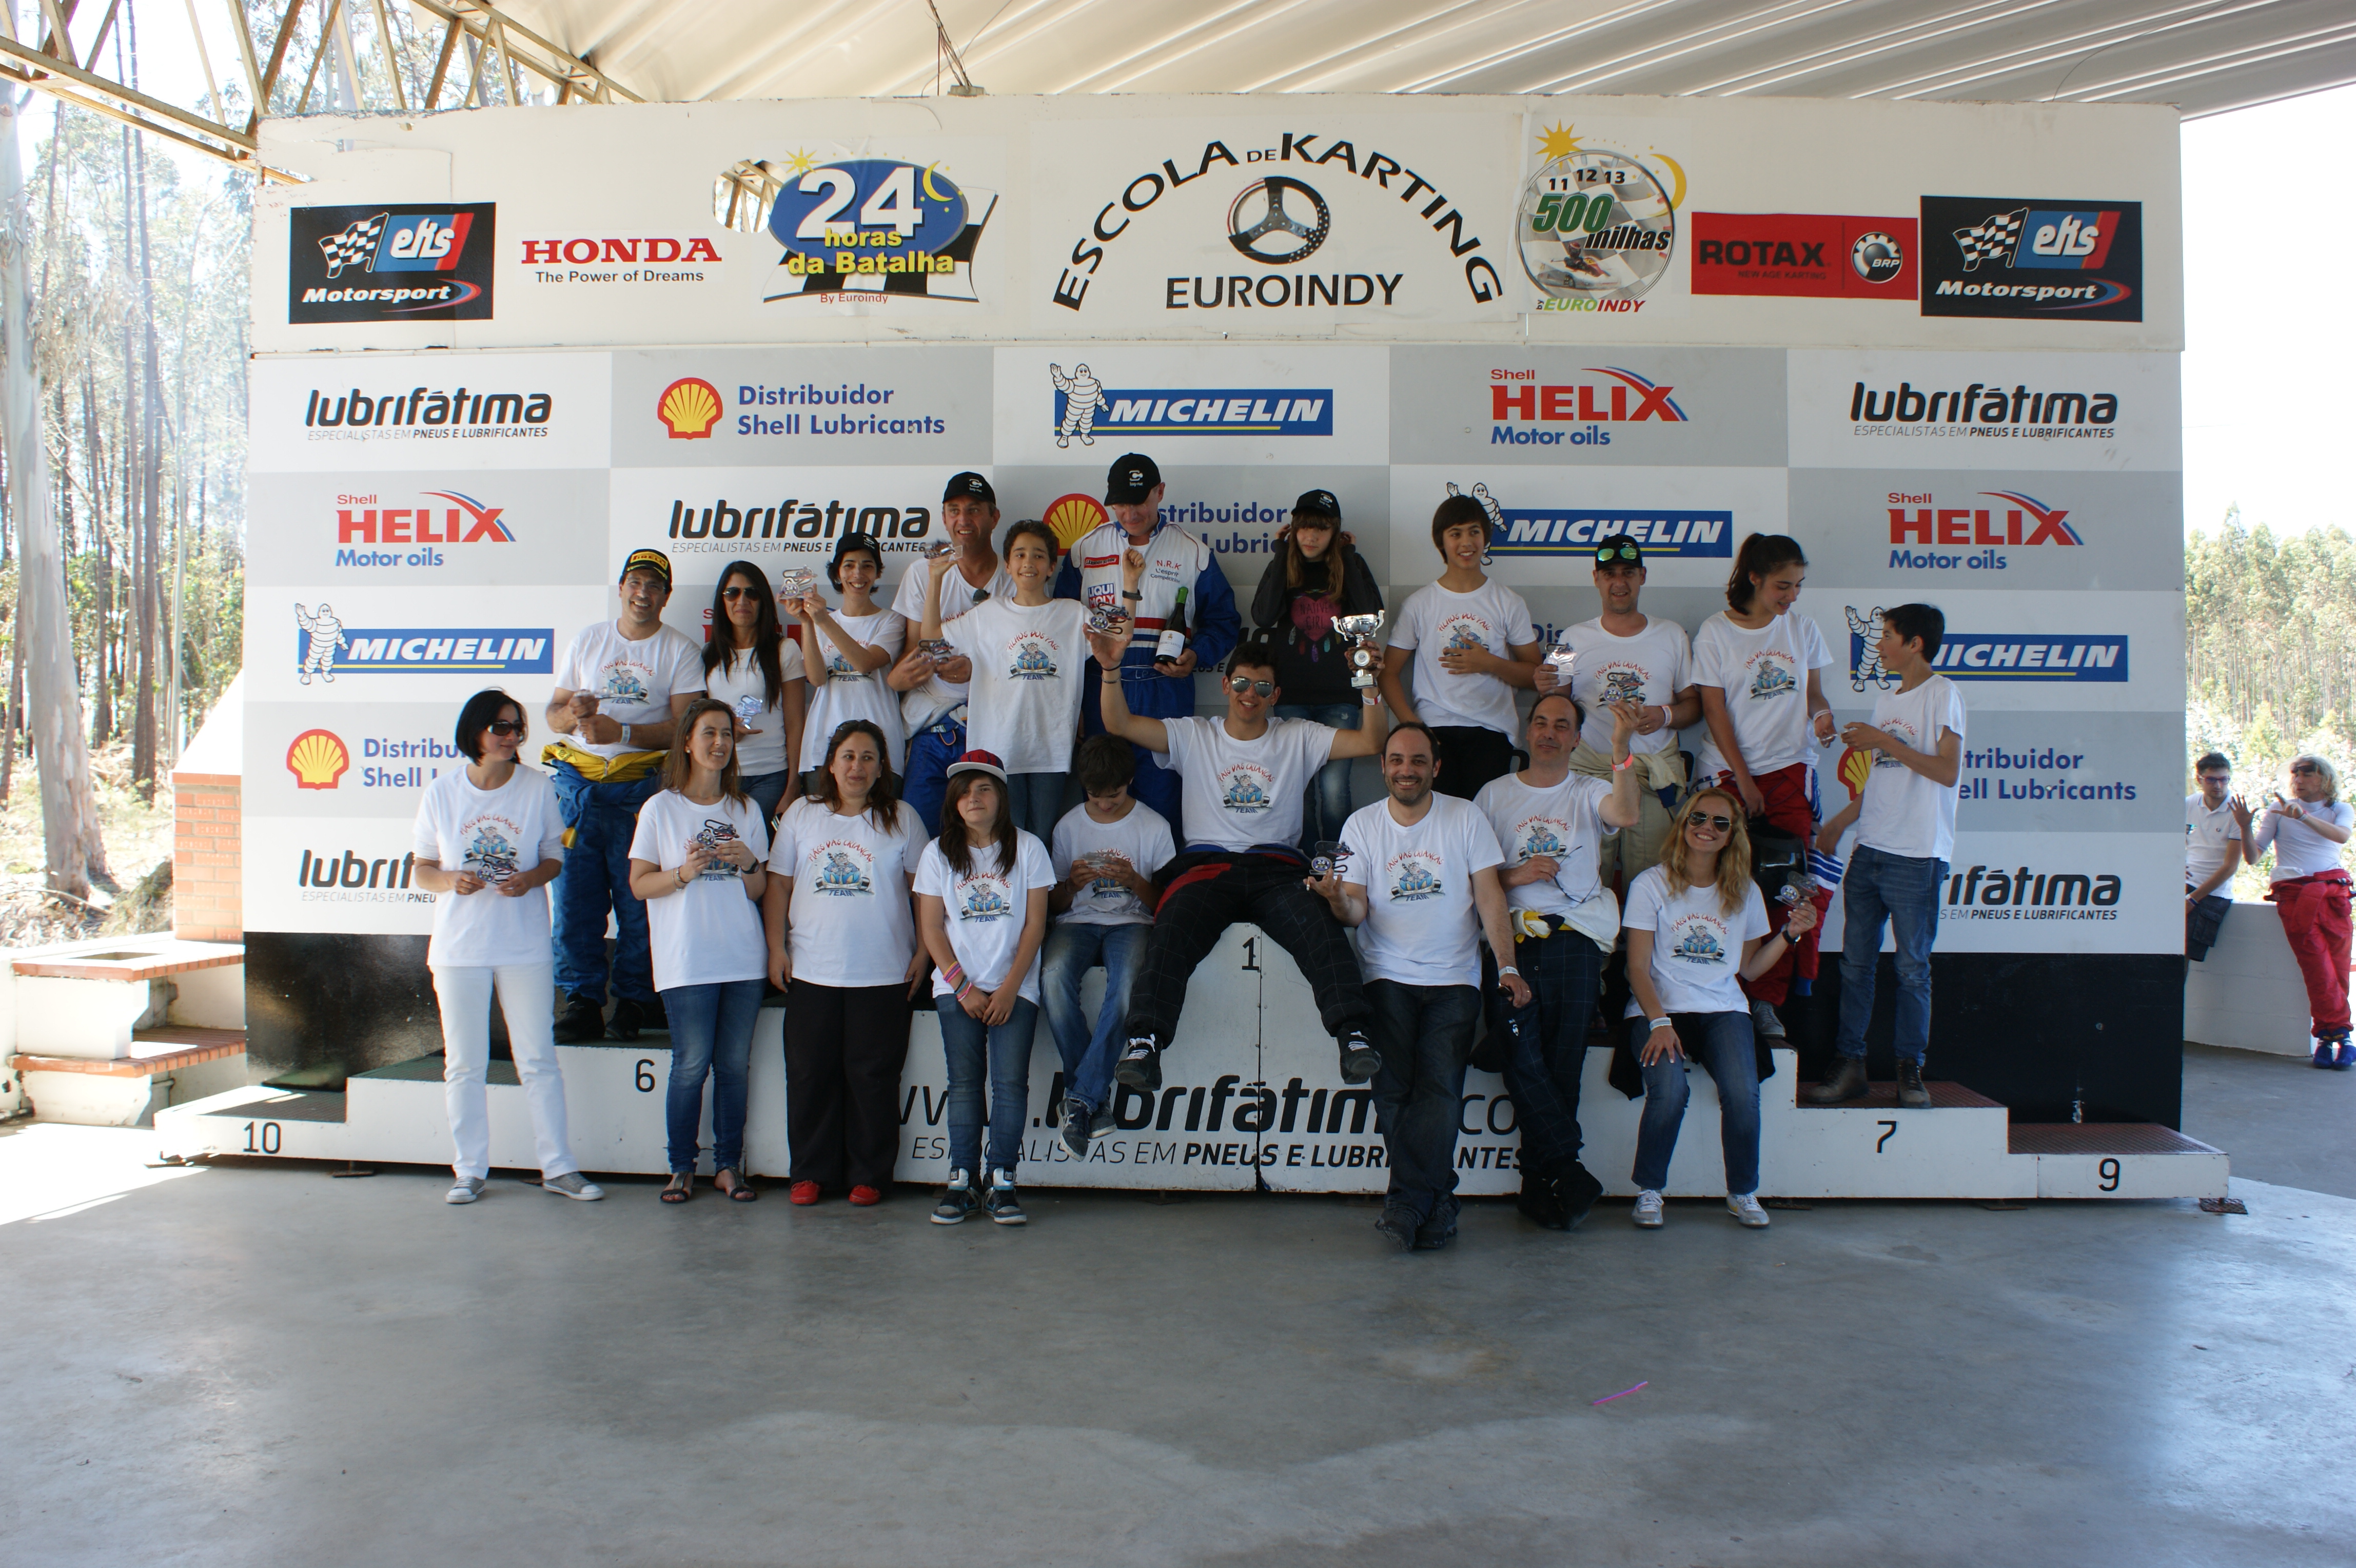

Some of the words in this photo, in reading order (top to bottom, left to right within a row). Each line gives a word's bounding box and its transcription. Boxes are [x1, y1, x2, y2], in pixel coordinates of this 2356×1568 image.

[1548, 178, 1569, 191] 11
[1576, 169, 1598, 183] 12
[1603, 171, 1626, 185] 13
[795, 167, 925, 240] 24
[1531, 193, 1615, 234] 500
[1052, 140, 1239, 311] ESCOLA
[1246, 149, 1277, 162] DE
[1281, 132, 1503, 304] KARTING
[824, 227, 903, 249] horas
[1583, 225, 1672, 251] milhas
[520, 238, 723, 265] HONDA
[1699, 239, 1825, 267] ROTAX
[788, 251, 824, 277] da
[835, 250, 955, 275] Batalha
[1872, 258, 1900, 268] BRP
[535, 270, 564, 283] The
[568, 269, 619, 282] Power
[623, 269, 640, 282] of
[643, 269, 705, 282] Dreams
[1738, 270, 1761, 279] NEW
[1763, 270, 1784, 279] AGE
[1785, 270, 1827, 280] KARTING
[302, 285, 451, 305] Motorsport
[821, 292, 835, 304] By
[838, 292, 889, 305] Euroindy
[1165, 273, 1404, 310] EUROINDY
[1935, 280, 2097, 302] Motorsport
[1544, 298, 1646, 313] EUROINDY
[1490, 369, 1536, 380] Shell
[739, 384, 894, 406] Distribuidor
[1489, 384, 1685, 422] HELIX
[1850, 381, 2118, 424] lubrifátima
[305, 387, 553, 427] lubrifátima
[1109, 399, 1325, 423] MICHELIN
[308, 429, 392, 441] ESPECIALISTAS
[394, 429, 411, 440] EM
[413, 428, 449, 439] PNEUS
[453, 428, 459, 439] E
[461, 426, 548, 438] LUBRIFICANTES
[737, 415, 801, 436] Shell
[810, 413, 946, 436] Lubricants
[1490, 426, 1565, 445] Motor
[1569, 425, 1611, 446] oils
[1853, 425, 1946, 437] ESPECIALISTAS
[1949, 426, 1967, 437] EM
[1969, 426, 2009, 438] PNEUS
[2012, 426, 2019, 438] E
[2021, 426, 2115, 439] LUBRIFICANTES
[337, 494, 377, 505] Shell
[1888, 492, 1932, 504] Shell
[336, 508, 512, 544] HELIX
[1506, 520, 1724, 544] MICHELIN
[1887, 508, 2080, 546] HELIX
[336, 548, 402, 567] Motor
[407, 547, 444, 566] oils
[672, 542, 760, 553] ESPECIALISTAS
[763, 542, 781, 553] EM
[783, 542, 822, 553] PNEUS
[824, 542, 832, 553] E
[1888, 550, 1962, 569] Motor
[1967, 550, 2007, 570] oils
[1088, 583, 1114, 597] LIQUI
[1089, 594, 1114, 608] MOLY
[1300, 601, 1329, 615] NATIVE
[1306, 616, 1325, 630] GIRL
[1437, 613, 1460, 632] FILHOS
[1461, 612, 1477, 621] DOS
[1476, 617, 1492, 631] PAIS
[347, 638, 546, 661] MICHELIN
[1006, 631, 1028, 651] FILHOS
[1030, 630, 1046, 639] DOS
[1045, 636, 1060, 651] PAIS
[1763, 690, 1784, 700] TEAM
[364, 738, 466, 759] Distribu
[1964, 747, 2084, 769] tribuidor
[363, 767, 422, 788] Shell
[1217, 768, 1231, 782] PAIS
[1231, 762, 1245, 773] DAS
[1958, 778, 1988, 799] ell
[1999, 779, 2136, 800] Lubricants
[1528, 814, 1542, 823] DAS
[808, 844, 825, 862] MÃES
[826, 838, 841, 848] DAS
[299, 849, 415, 889] lubrif
[1385, 858, 1399, 872] PAIS
[1399, 851, 1412, 861] DAS
[1944, 865, 2122, 907] ifátima
[302, 891, 386, 903] ESPECIALISTAS
[388, 892, 405, 903] EM
[407, 892, 437, 904] PNEU
[1405, 894, 1429, 902] TEAM
[1950, 909, 1969, 919] EM
[1971, 909, 2011, 920] PNEUS
[2013, 910, 2021, 920] E
[2023, 910, 2117, 921] LUBRIFICANTES
[1242, 937, 1260, 971] 1
[1686, 957, 1711, 965] TEAM
[636, 1059, 656, 1093] 6
[243, 1121, 282, 1154] 10
[1877, 1120, 1898, 1154] 7
[1134, 1142, 1177, 1165] EM
[1183, 1143, 1278, 1166] PNEUS
[1286, 1144, 1304, 1167] E
[2098, 1157, 2121, 1191] 9
